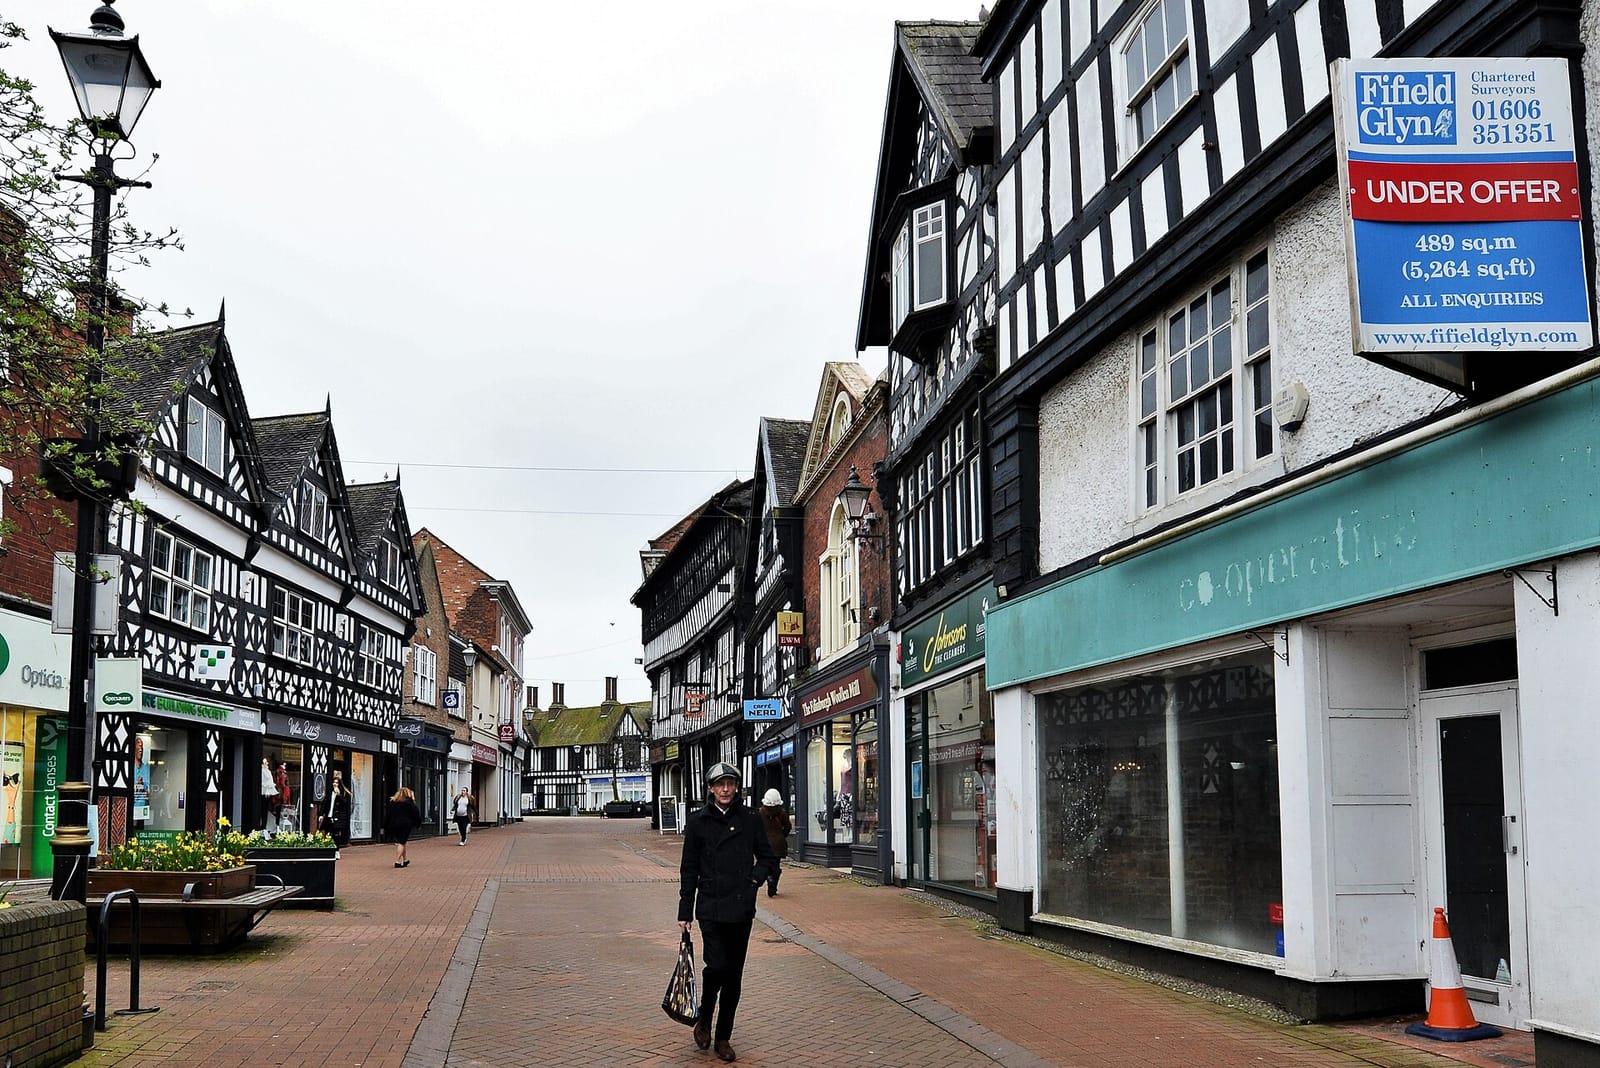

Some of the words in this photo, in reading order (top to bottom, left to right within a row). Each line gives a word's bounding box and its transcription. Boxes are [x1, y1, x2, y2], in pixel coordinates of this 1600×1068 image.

[1471, 70, 1536, 83] Chartered
[1360, 73, 1454, 105] Fifield
[1471, 84, 1536, 97] Surveyors
[1472, 99, 1541, 120] 01606
[1359, 106, 1434, 143] Glyn
[1472, 122, 1556, 144] 351351
[1367, 179, 1465, 204] UNDER
[1470, 179, 1562, 203] OFFER
[1415, 234, 1455, 252] 489
[1461, 236, 1517, 254] sq.m
[1401, 260, 1470, 281] (5,264
[1477, 257, 1536, 280] sq.ft)
[1400, 294, 1437, 308] ALL
[1441, 292, 1544, 309] ENQUIRIES
[1374, 327, 1579, 347] www.fifieldglyn.com
[780, 636, 801, 644] EWM
[923, 612, 967, 673] Johnsons
[934, 654, 943, 665] THE
[943, 643, 966, 661] CLEANERS
[21, 665, 66, 689] Opticia
[156, 696, 197, 716] BUILDING
[197, 704, 229, 721] SOCIETY
[802, 702, 811, 717] The
[809, 692, 833, 712] Edinburgh
[848, 678, 861, 698] Mill
[748, 709, 777, 717] NERO
[336, 733, 356, 744] BOUTIQUE
[44, 755, 57, 792] Lenses
[42, 795, 56, 837] Contact
